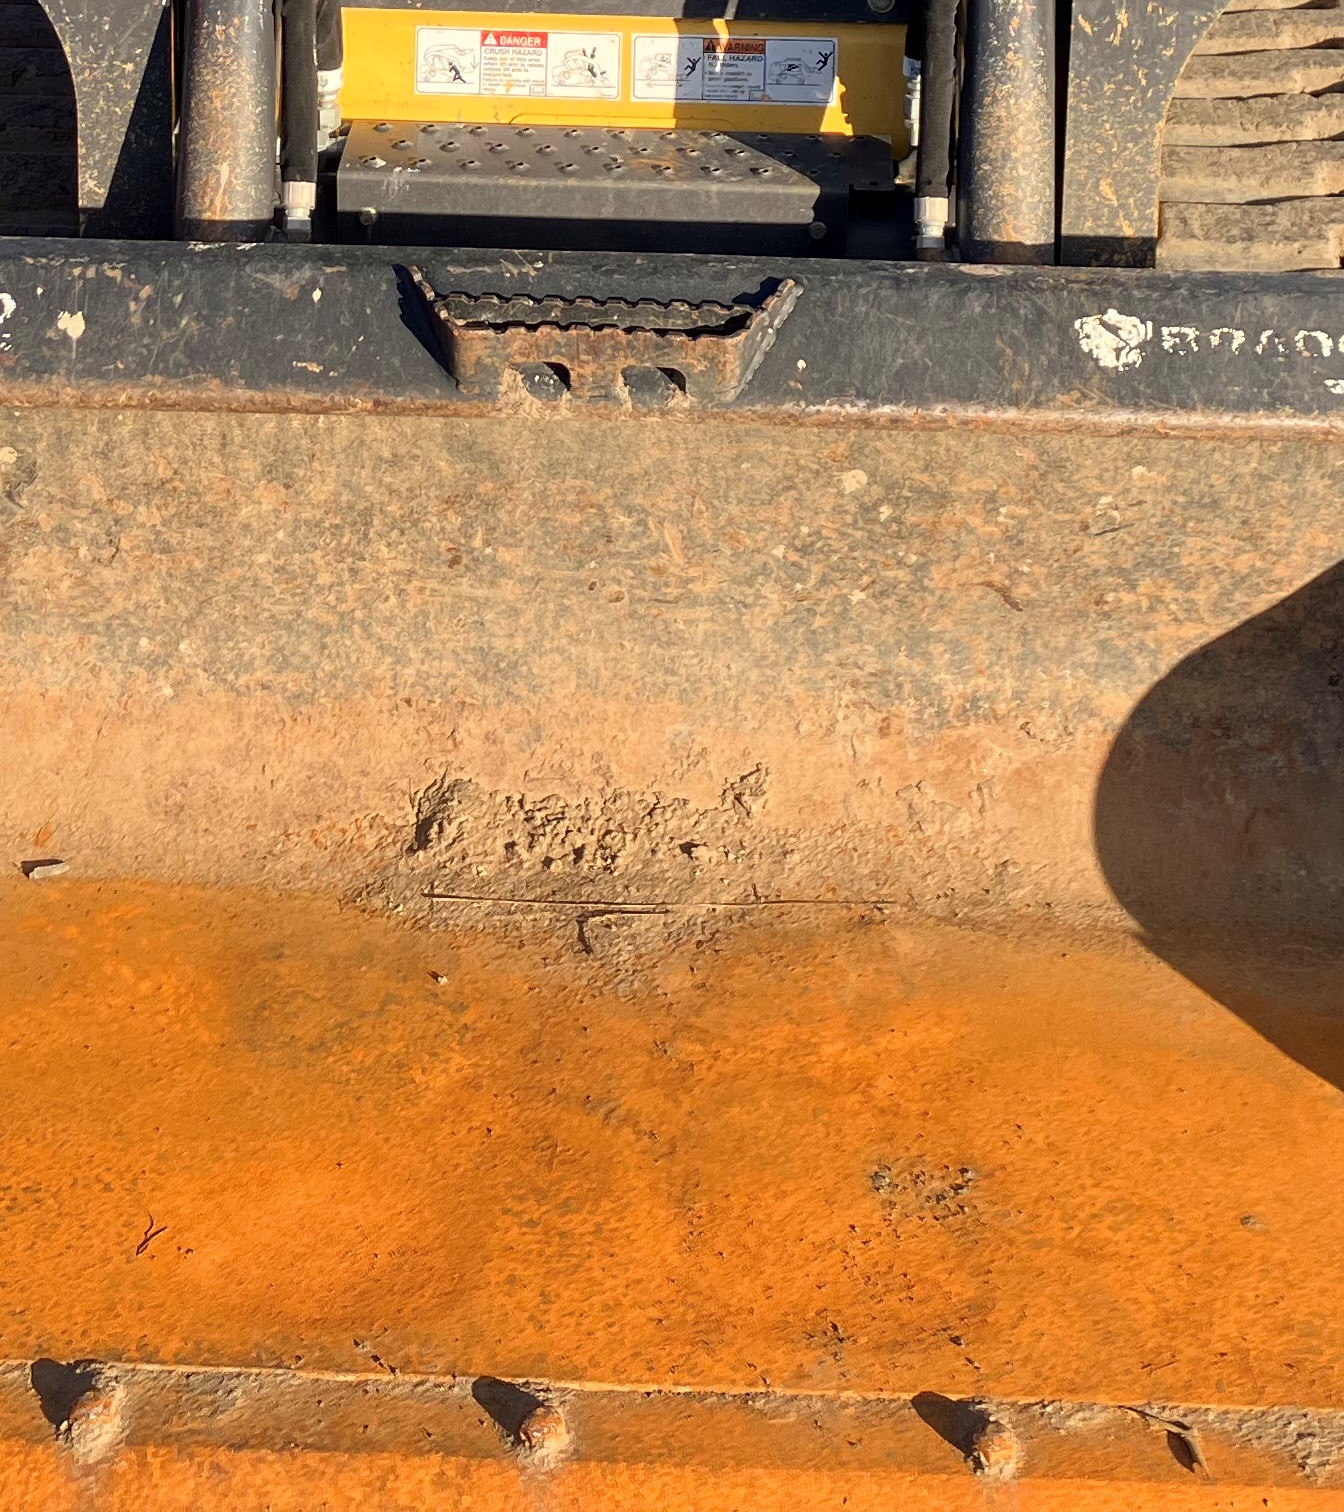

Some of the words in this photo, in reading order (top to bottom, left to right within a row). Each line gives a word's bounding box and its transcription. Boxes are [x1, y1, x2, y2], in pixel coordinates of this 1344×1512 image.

[499, 35, 542, 47] DANGER
[484, 48, 511, 56] CRUSH
[511, 49, 543, 57] HAZARD
[729, 54, 763, 62] HAZARD
